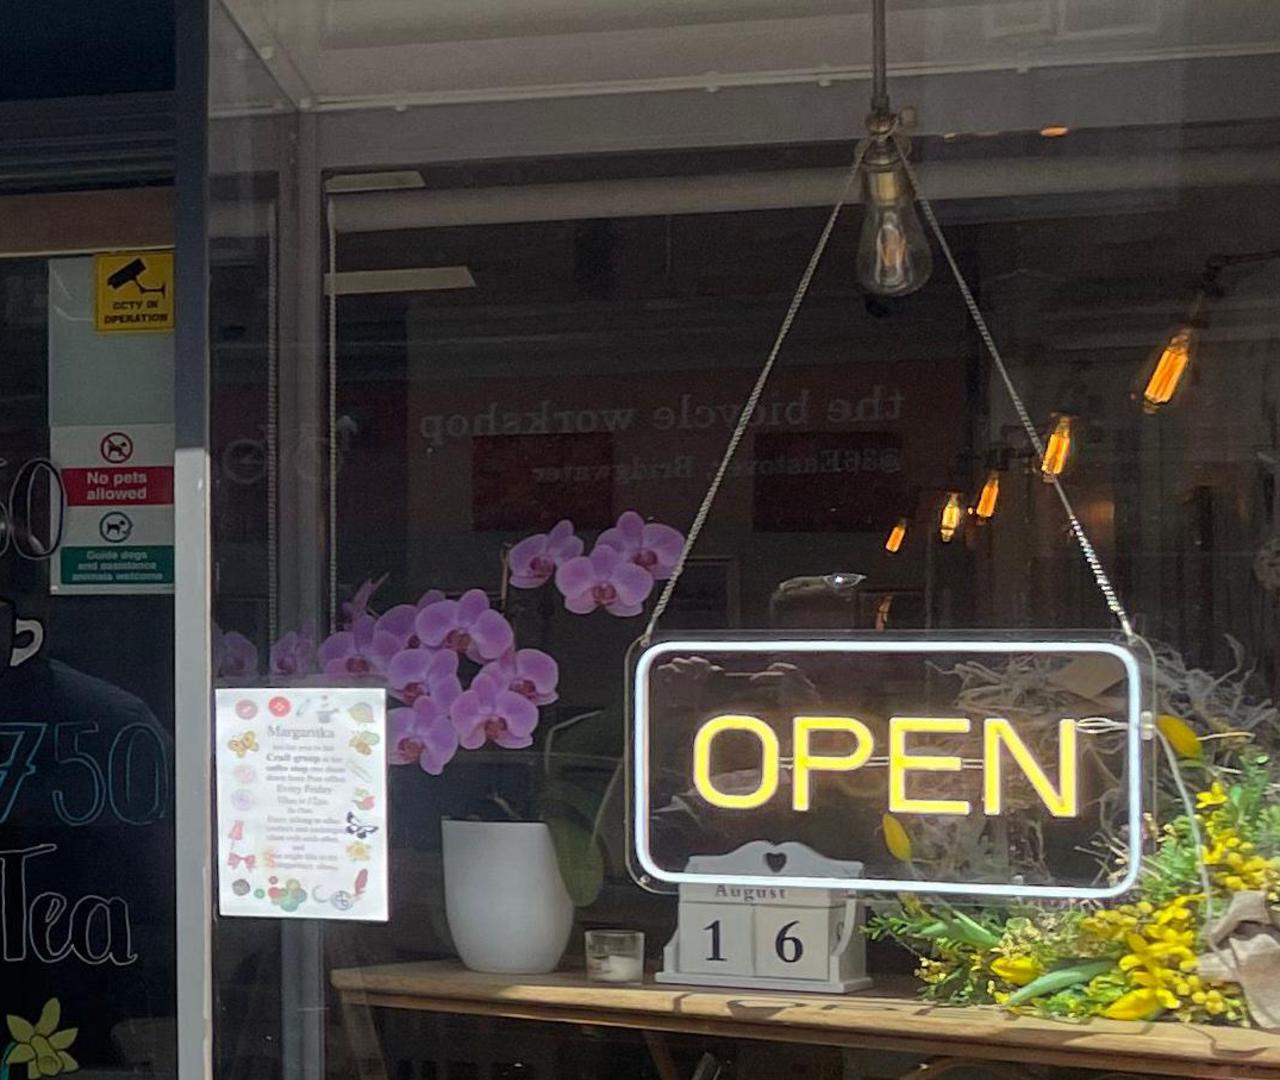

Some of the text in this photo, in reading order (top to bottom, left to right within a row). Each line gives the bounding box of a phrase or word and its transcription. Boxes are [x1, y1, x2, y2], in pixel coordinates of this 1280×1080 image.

[104, 313, 168, 324] OPERATION
[86, 473, 148, 487] No pets
[86, 486, 147, 500] allowed
[692, 714, 1079, 818] OPEN
[713, 884, 786, 902] August
[702, 919, 805, 964] 1 6
